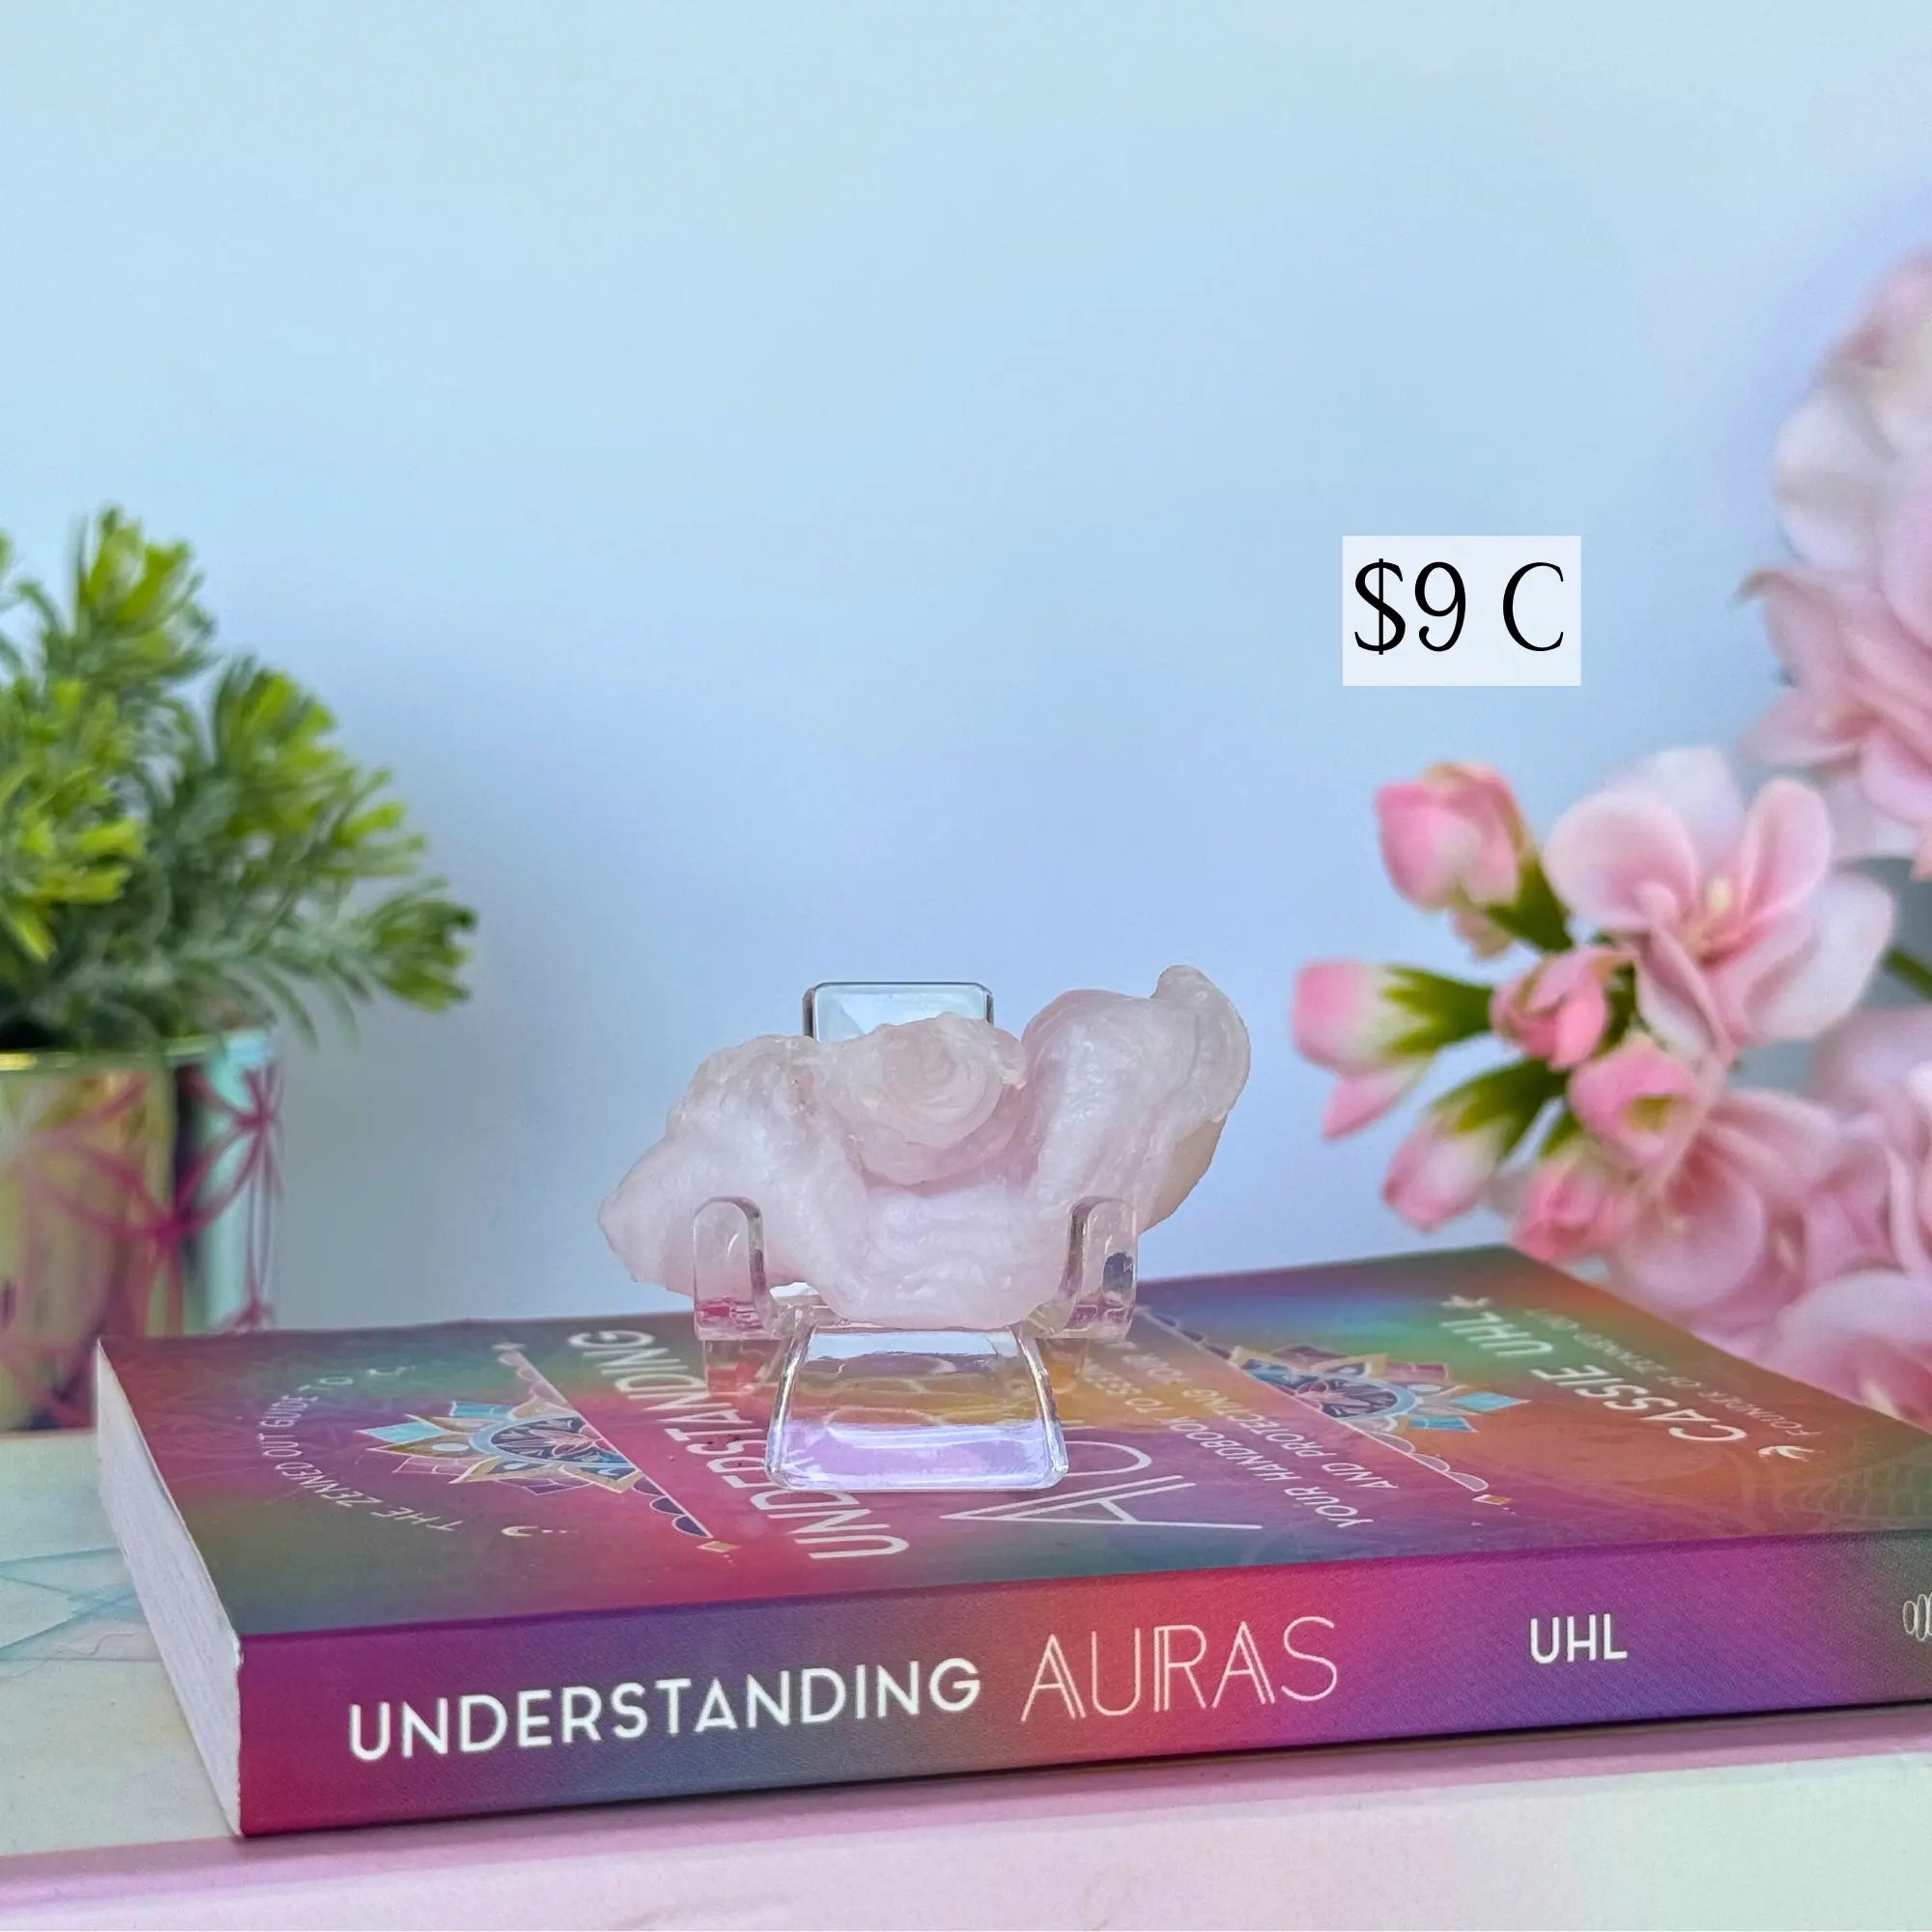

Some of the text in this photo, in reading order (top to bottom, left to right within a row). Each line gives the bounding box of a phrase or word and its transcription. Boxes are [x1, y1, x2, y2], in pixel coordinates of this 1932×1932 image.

[1440, 1311, 1747, 1442] CASSIE UHL
[260, 1394, 319, 1428] GUIDE
[1124, 1398, 1174, 1413] TO
[1180, 1388, 1338, 1457] PROTECTING
[258, 1433, 303, 1458] OUT
[1154, 1415, 1302, 1482] HANDBOOK
[274, 1462, 384, 1508] ZENNED
[1321, 1463, 1399, 1490] AND
[370, 1506, 464, 1532] THE
[1284, 1487, 1374, 1528] YOUR
[349, 1613, 1628, 1762] UNDERSTANDING AURAS UHL
